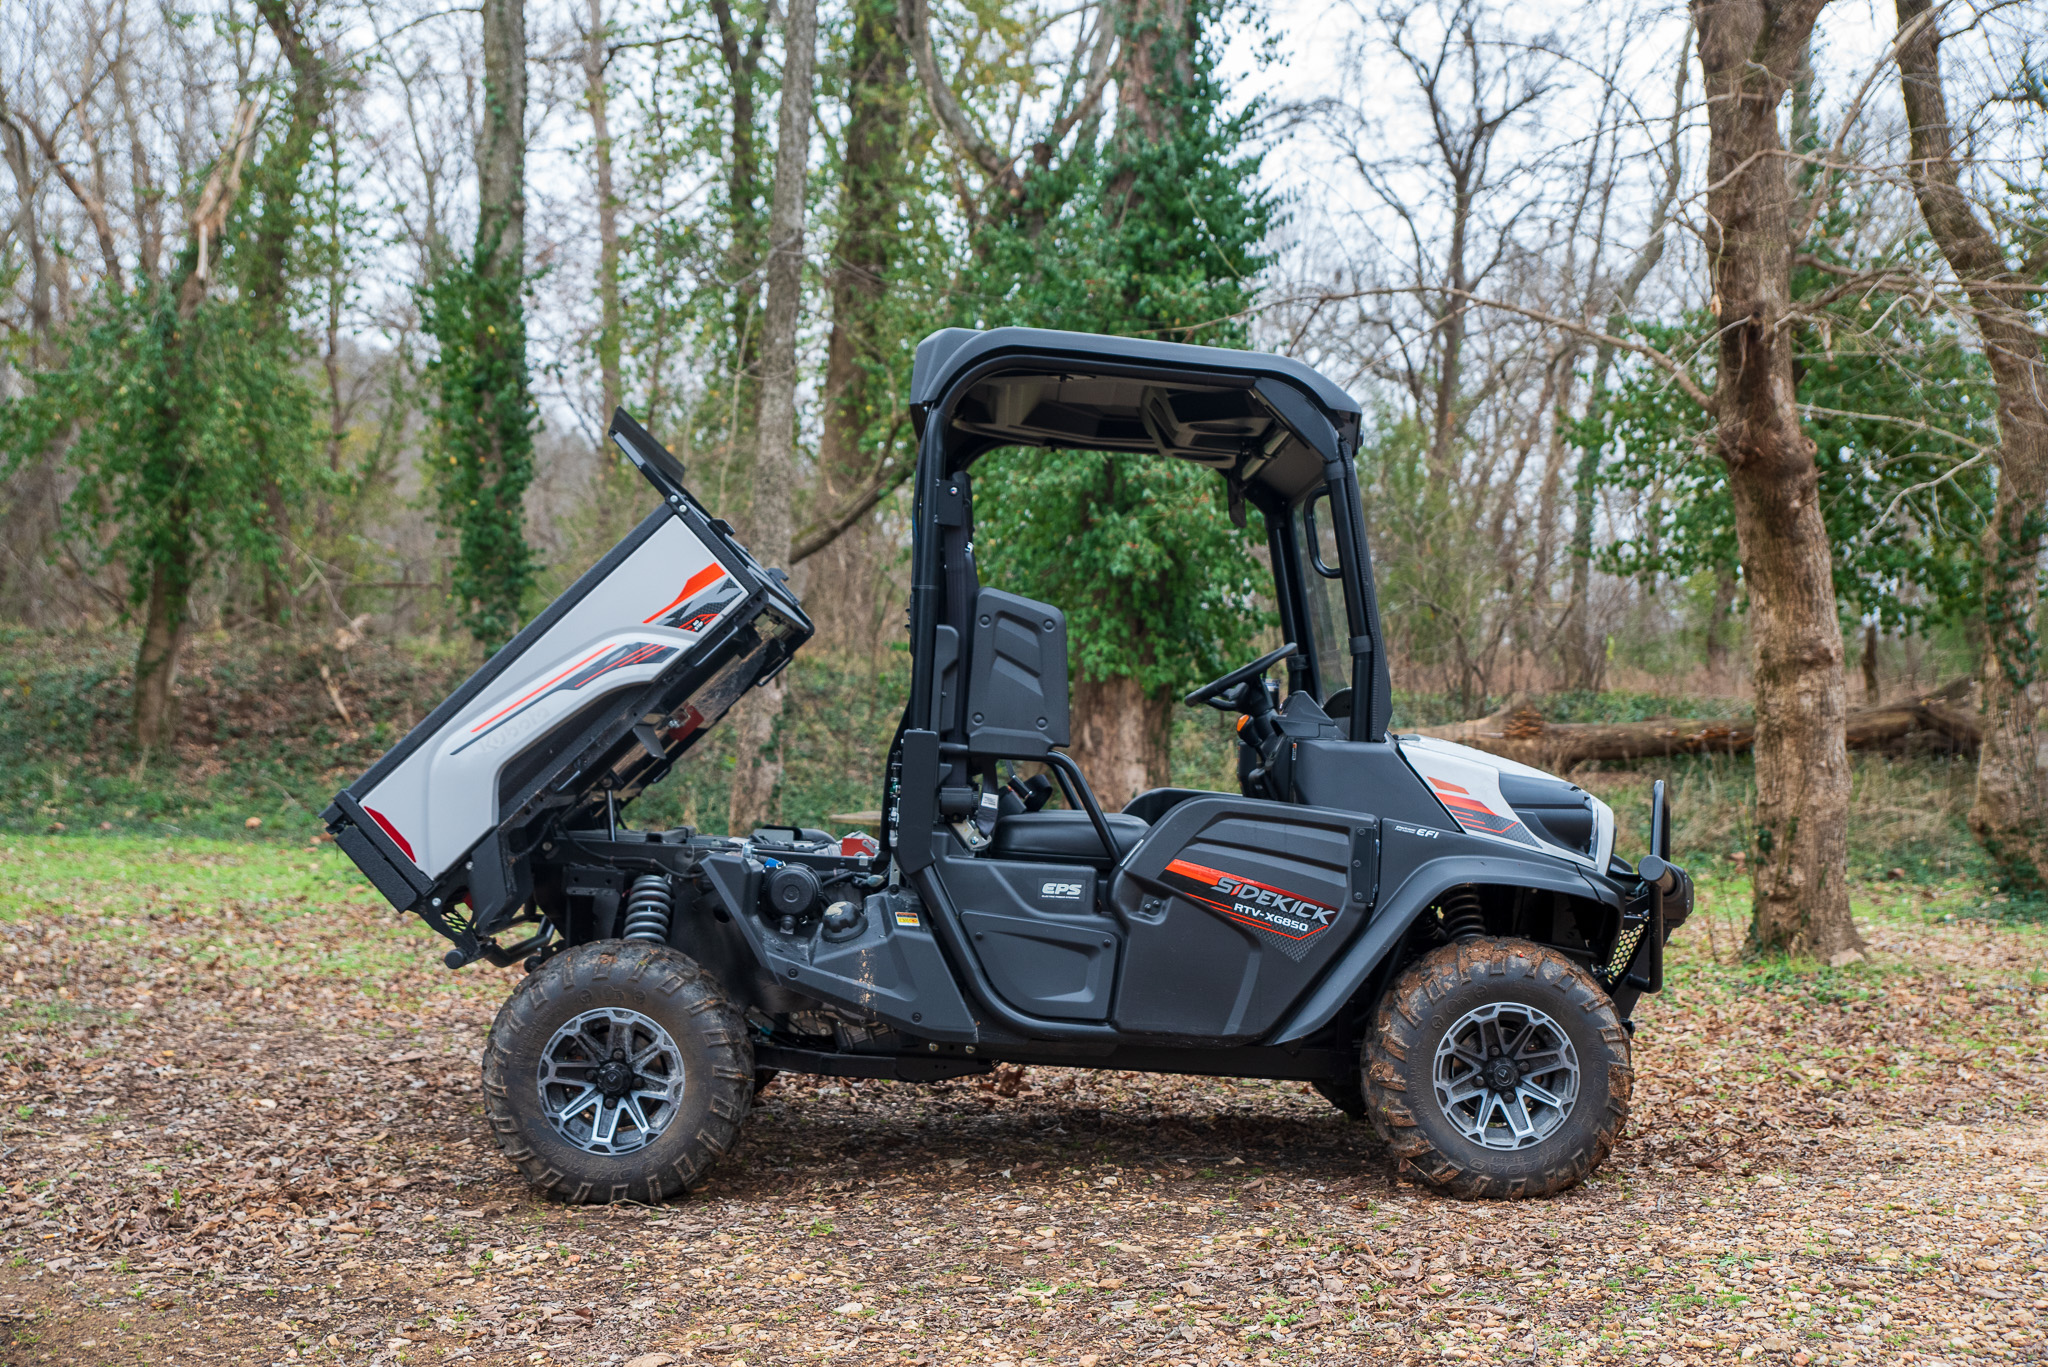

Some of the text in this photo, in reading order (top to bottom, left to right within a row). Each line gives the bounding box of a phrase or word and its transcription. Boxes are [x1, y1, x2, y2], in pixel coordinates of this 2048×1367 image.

[1416, 828, 1440, 839] EFI
[1041, 882, 1083, 896] EPS
[1210, 876, 1337, 926] SIDEKICK
[1233, 902, 1309, 932] RTV-XG850
